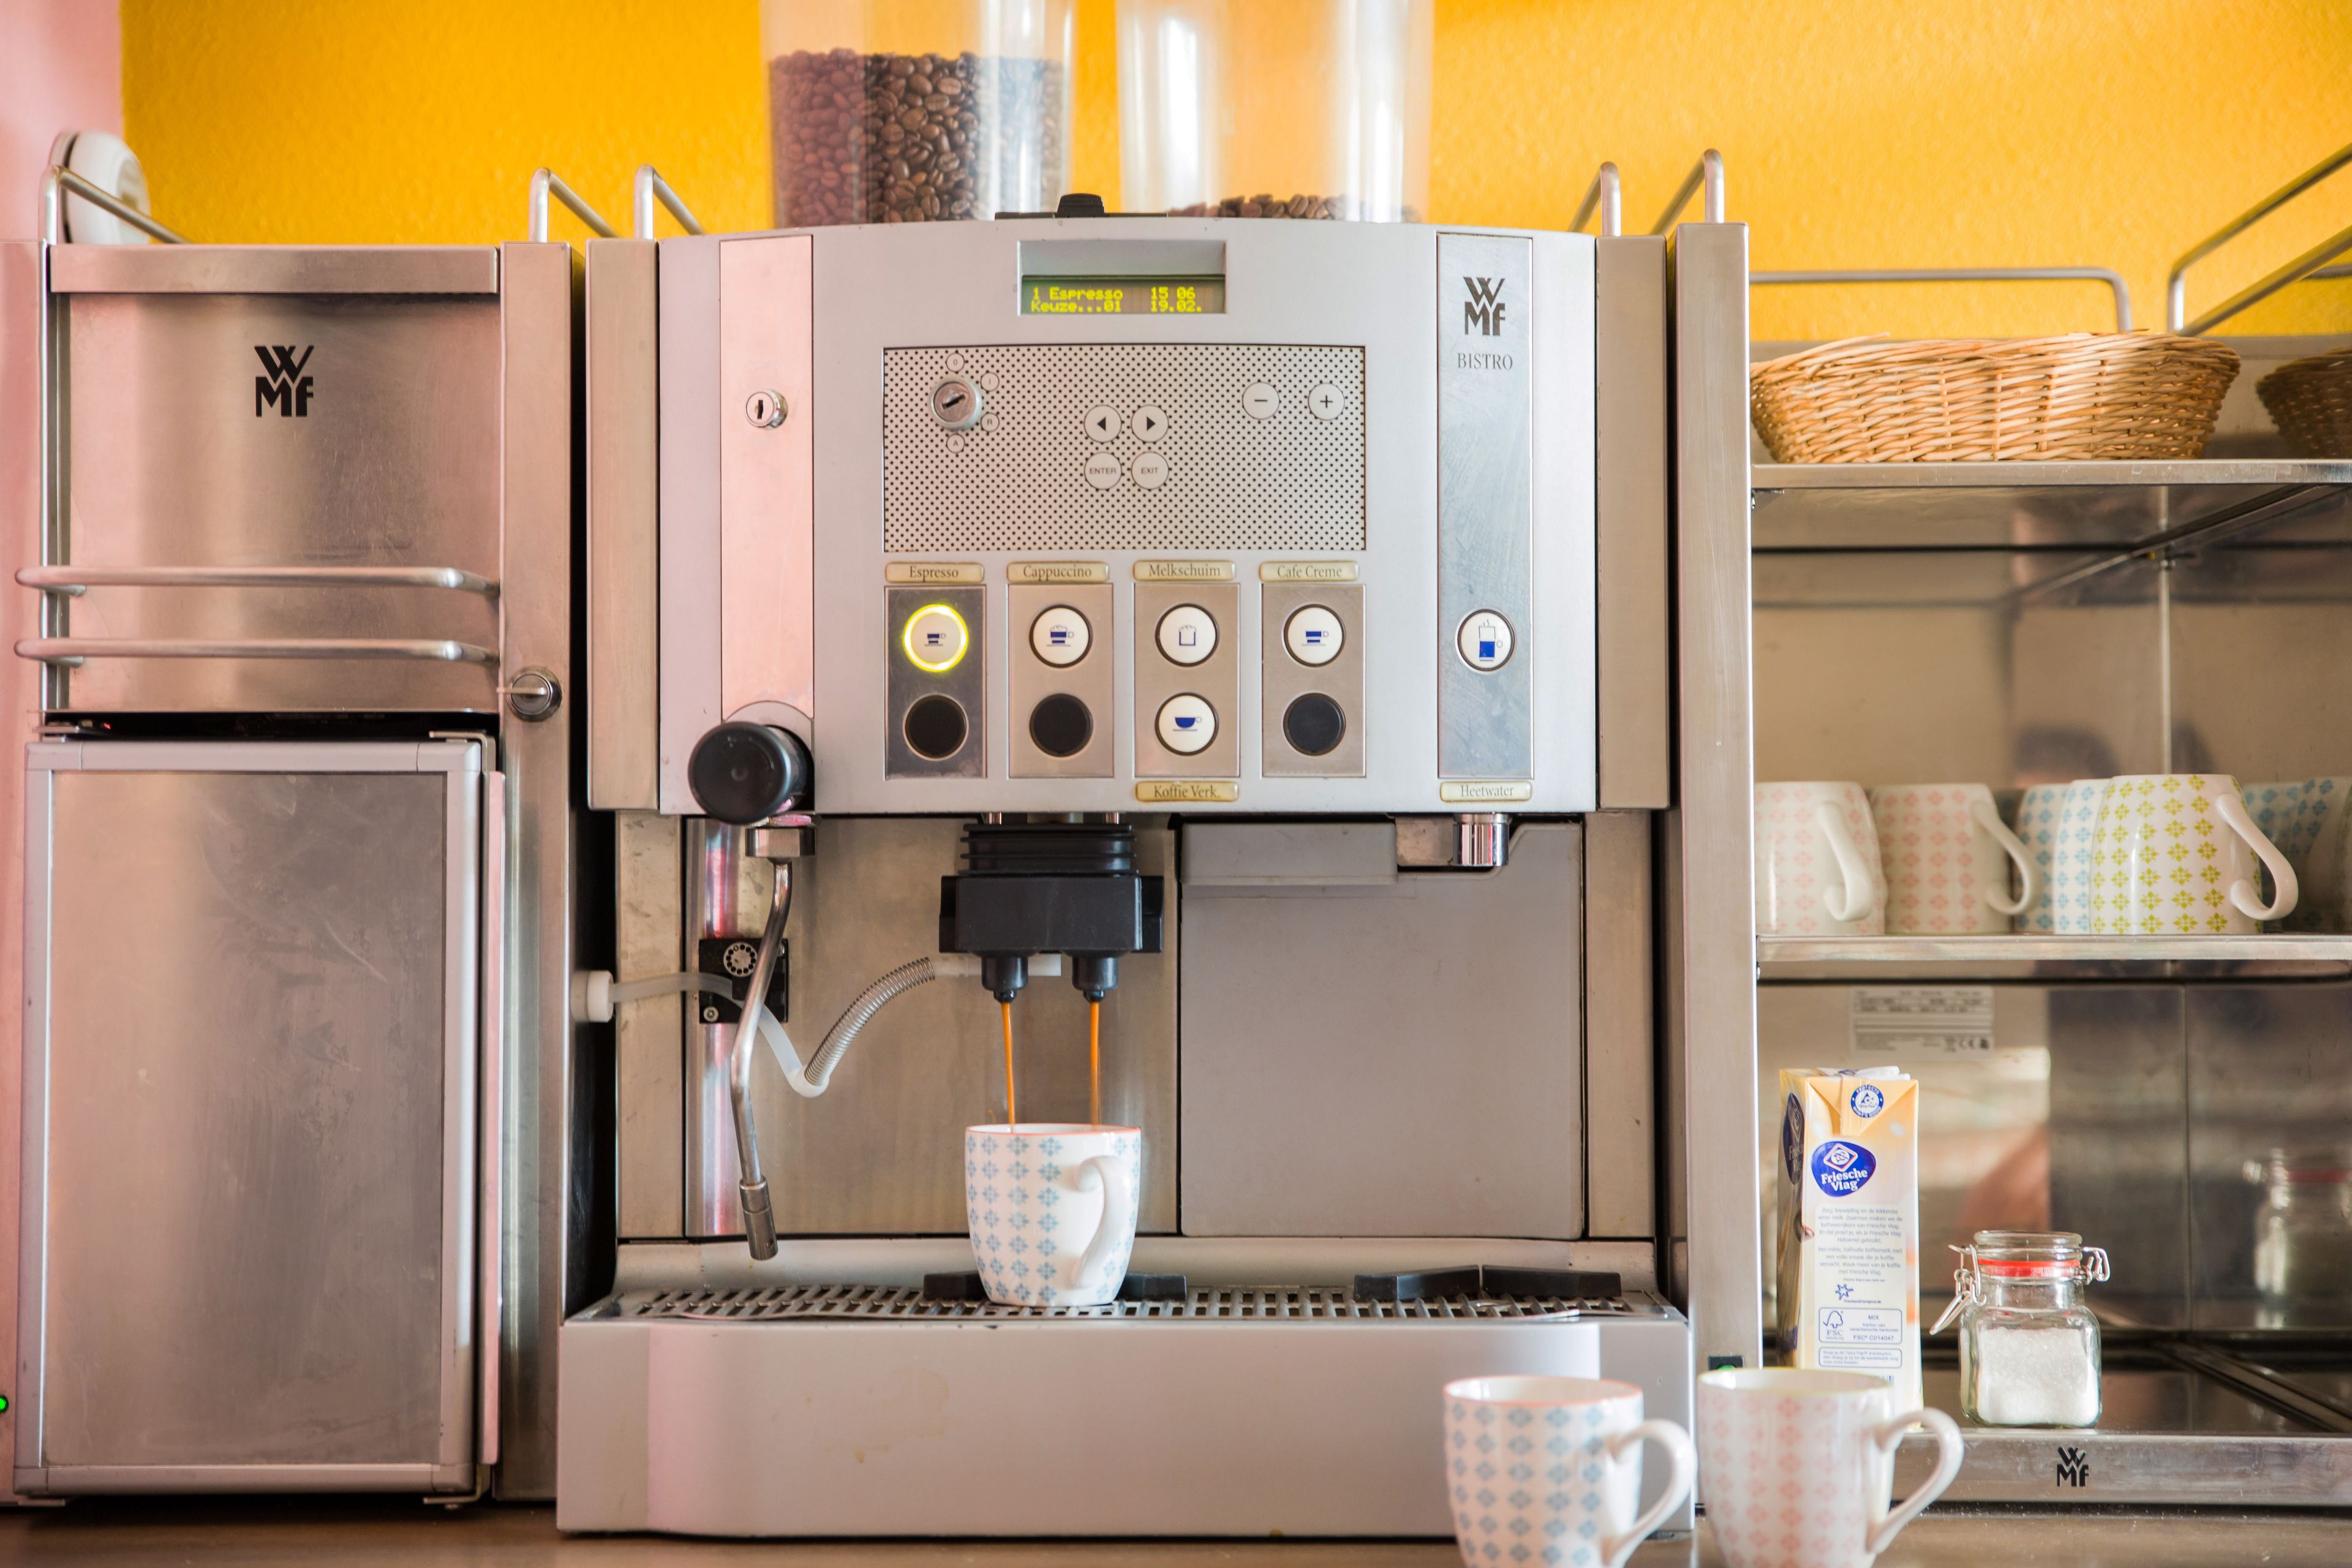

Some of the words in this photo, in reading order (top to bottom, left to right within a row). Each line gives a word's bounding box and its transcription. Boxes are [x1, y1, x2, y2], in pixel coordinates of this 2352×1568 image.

[1049, 287, 1123, 301] Espresso
[1151, 287, 1169, 300] 15
[1176, 287, 1196, 300] 06
[1463, 276, 1506, 336] WMF
[1457, 353, 1513, 370] BISTRO
[254, 345, 314, 417] WMF
[908, 565, 959, 580] Espresso
[1023, 565, 1092, 581] Cappuccino
[1148, 562, 1221, 578] Melkschuim
[1277, 565, 1305, 579] Cafe
[1305, 565, 1343, 579] Creme
[1153, 783, 1189, 799] Koffie
[1189, 784, 1221, 799] Verk.
[1460, 784, 1515, 797] Heetwater
[1820, 1167, 1868, 1185] Friesche
[1831, 1180, 1859, 1192] Vlag
[2057, 1446, 2090, 1487] WMF
